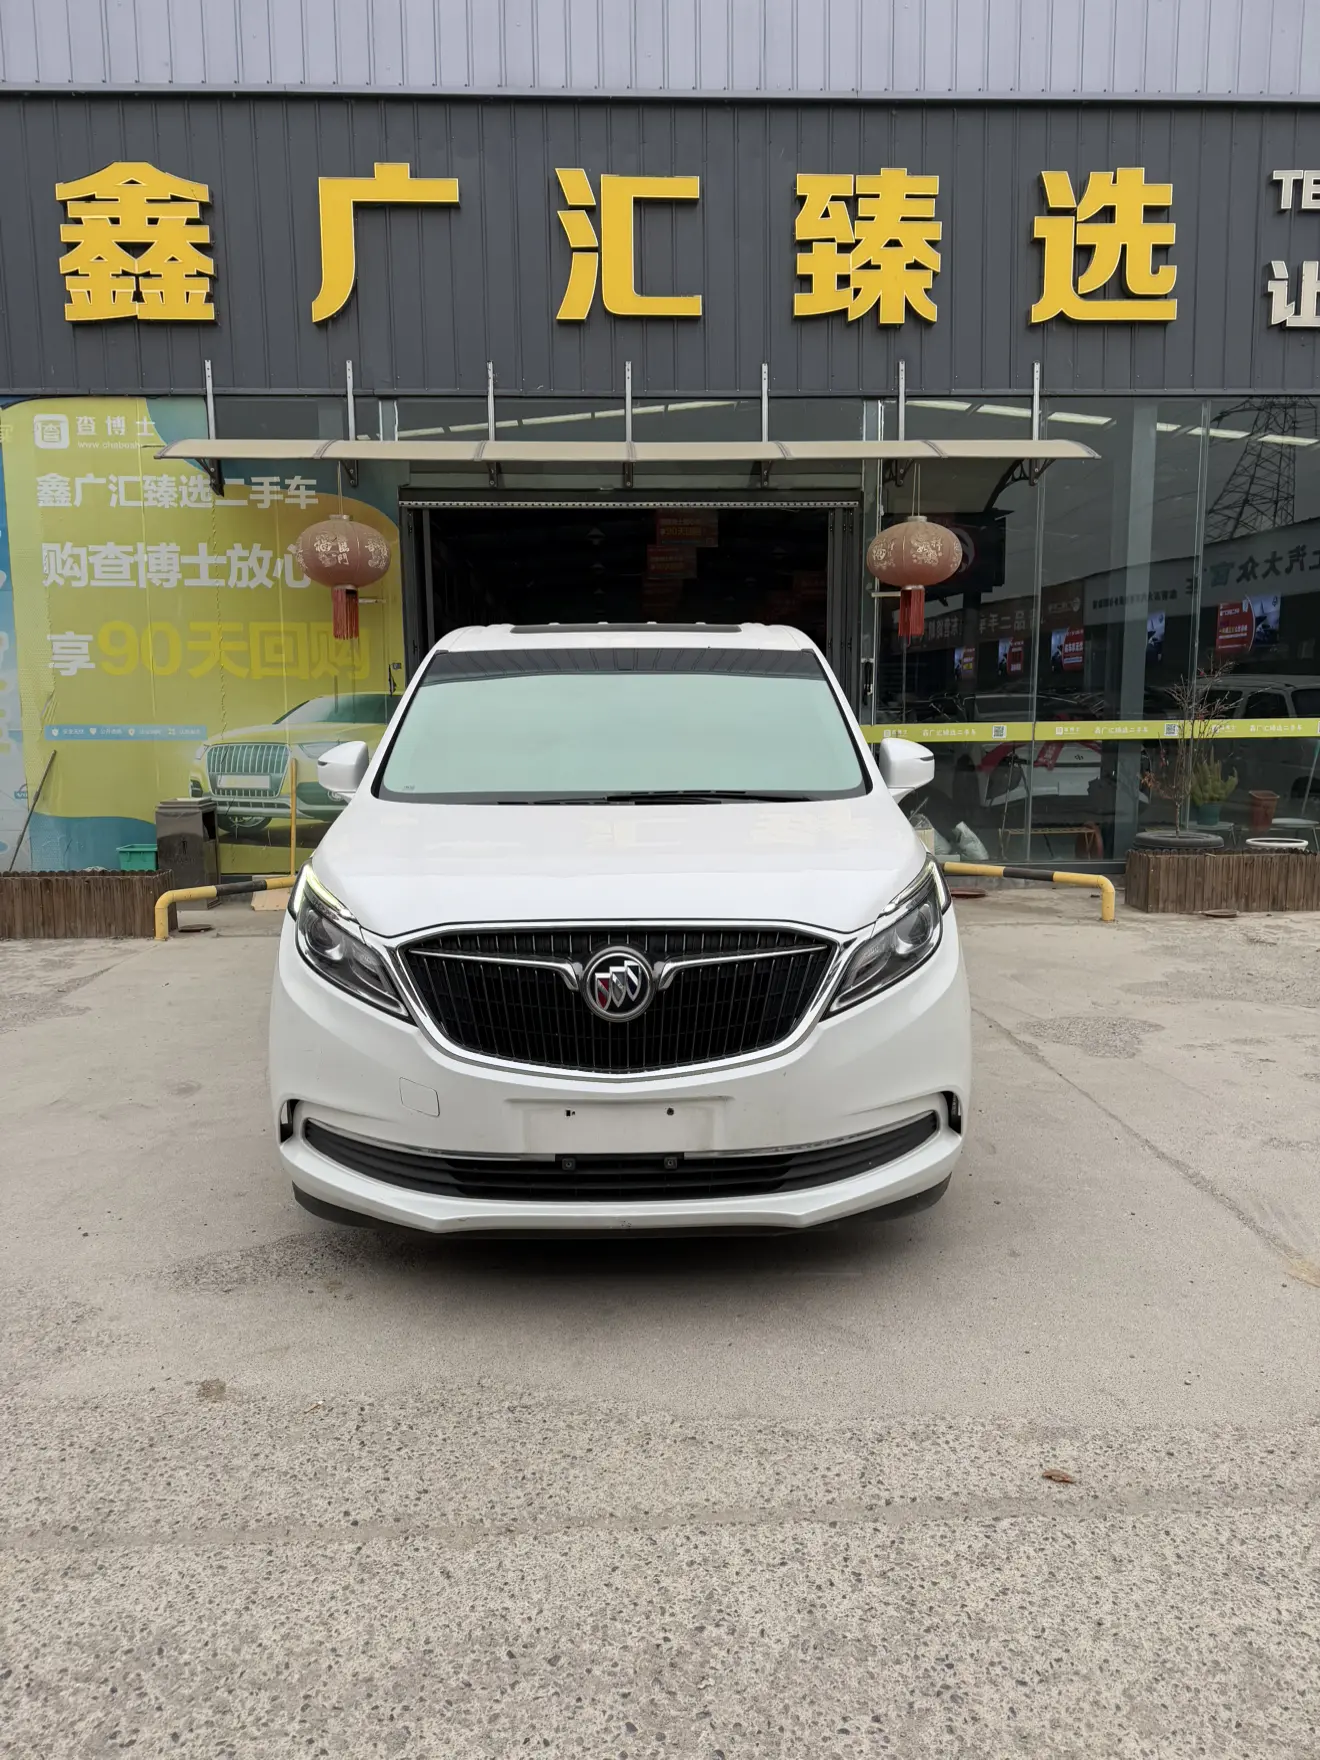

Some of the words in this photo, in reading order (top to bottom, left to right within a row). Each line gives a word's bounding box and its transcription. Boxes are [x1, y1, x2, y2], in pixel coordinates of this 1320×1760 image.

[54, 161, 1180, 325] 鑫广汇臻选
[76, 415, 156, 437] 查博士
[36, 473, 319, 510] 鑫广汇臻选二手车
[42, 541, 312, 589] 购查博士放心
